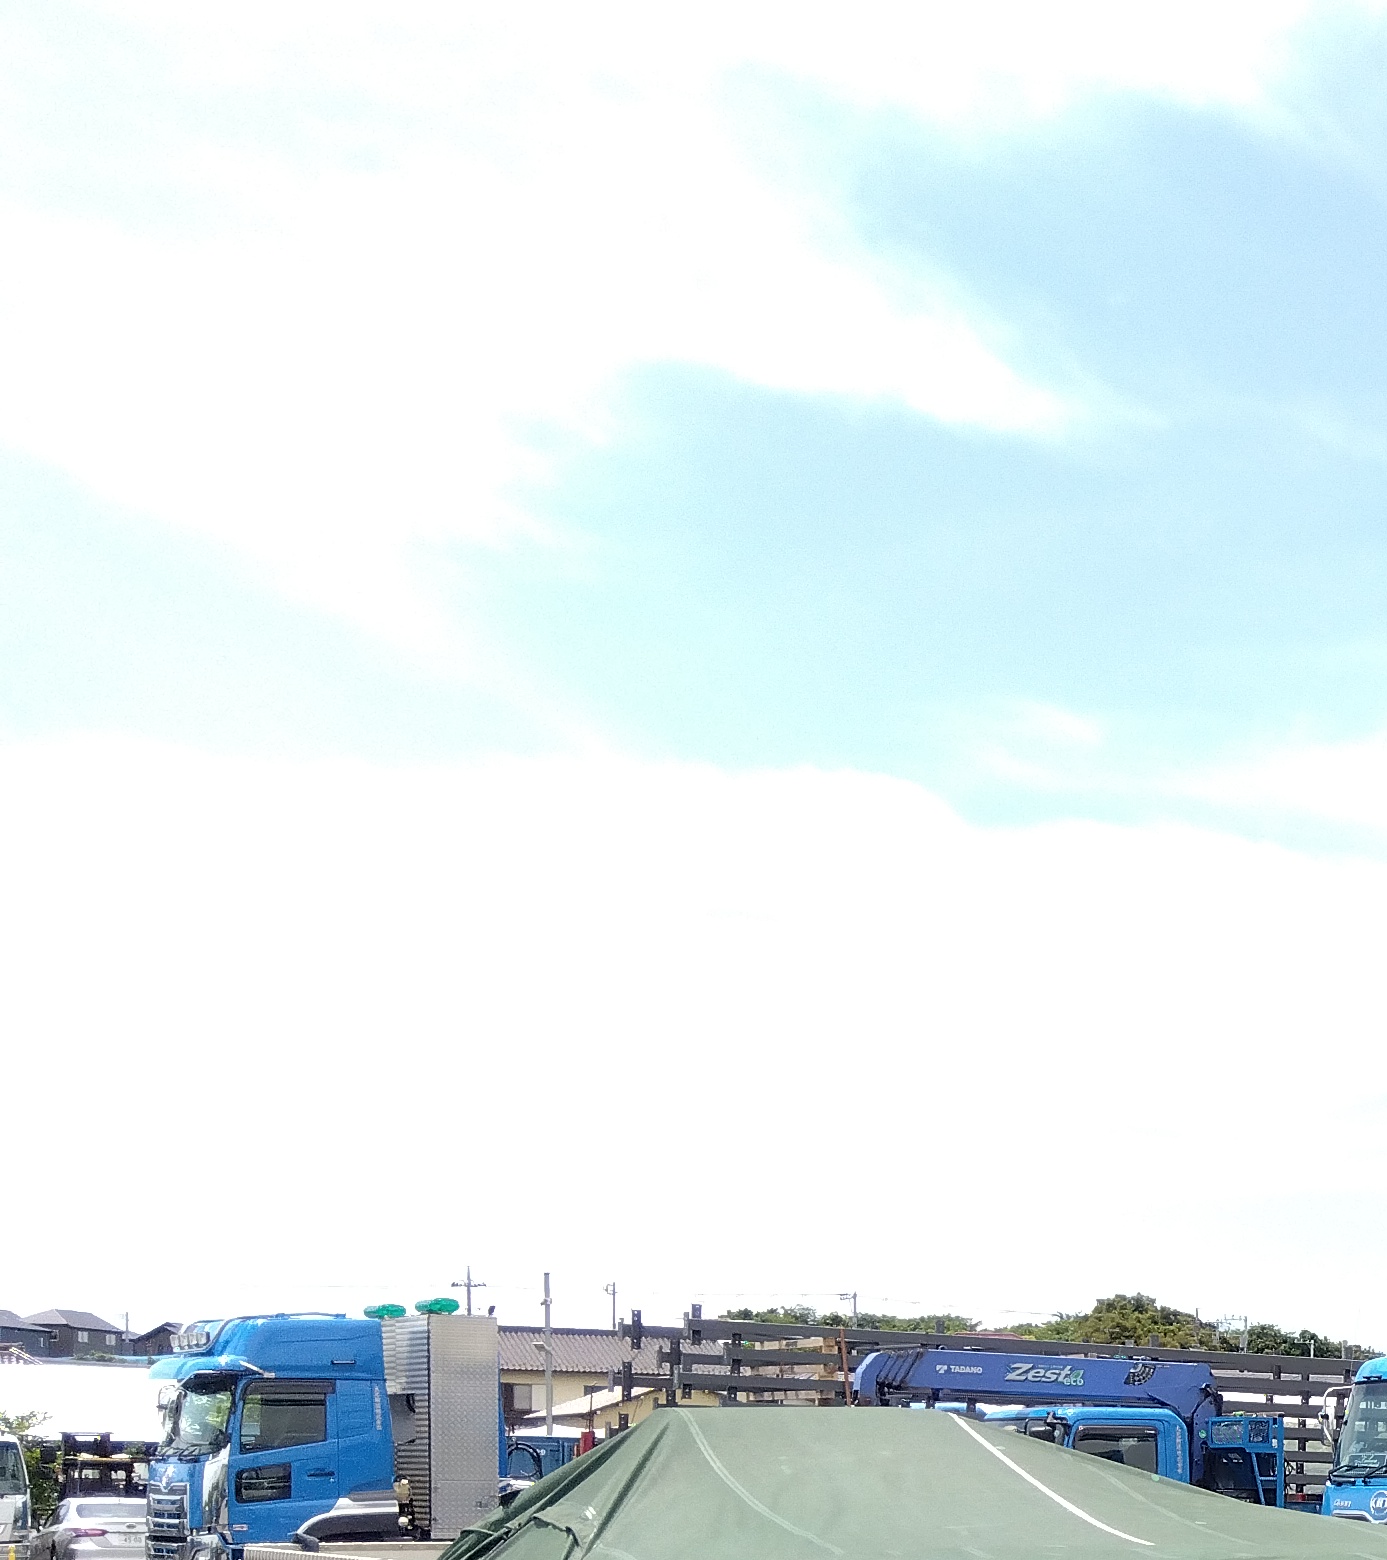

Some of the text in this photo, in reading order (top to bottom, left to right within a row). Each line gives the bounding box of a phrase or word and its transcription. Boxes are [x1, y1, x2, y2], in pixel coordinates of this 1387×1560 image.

[950, 1365, 983, 1374] TADANO
[1004, 1363, 1072, 1383] Zest
[1064, 1378, 1084, 1386] eco
